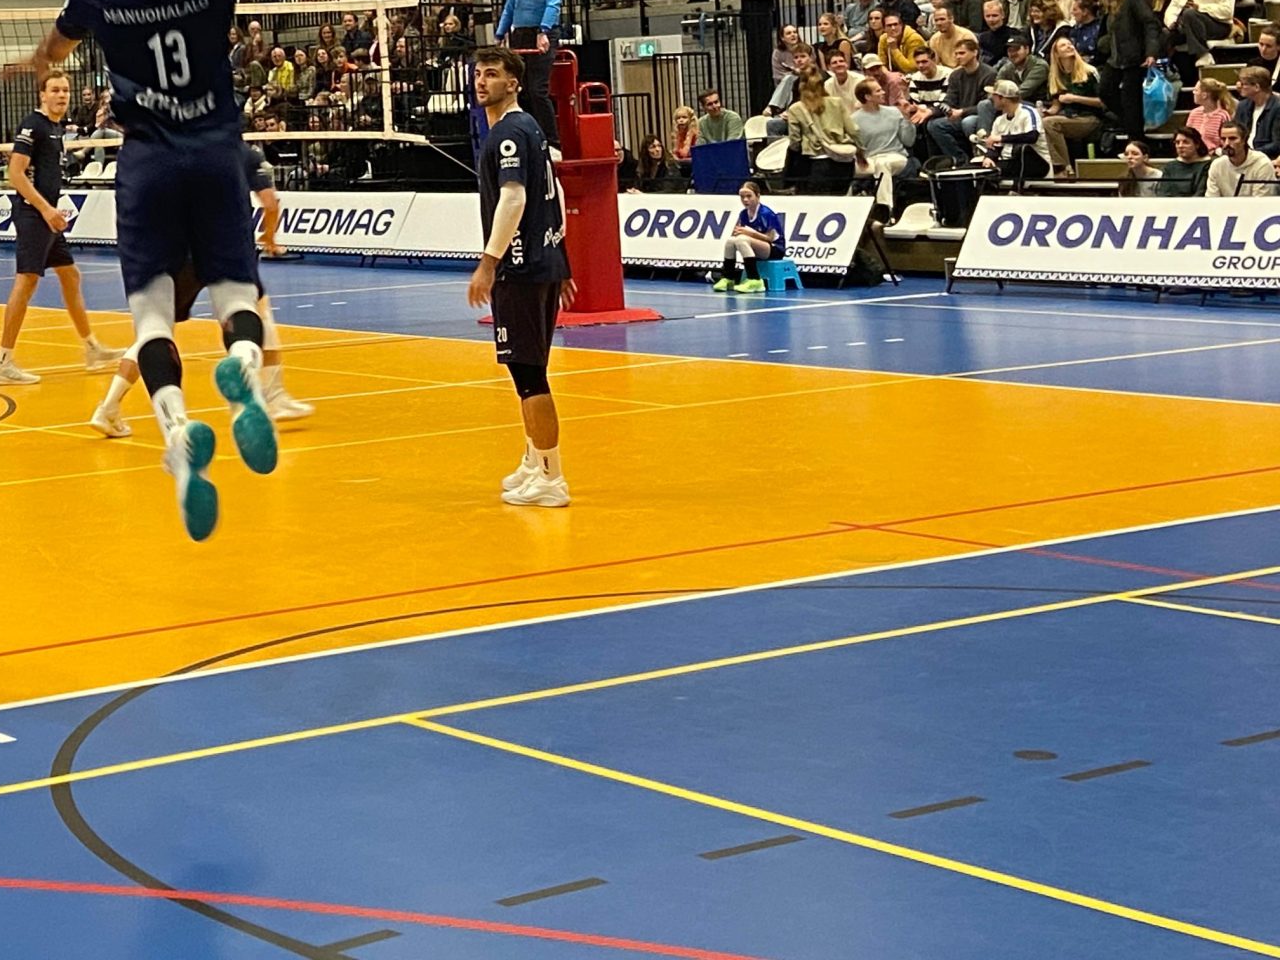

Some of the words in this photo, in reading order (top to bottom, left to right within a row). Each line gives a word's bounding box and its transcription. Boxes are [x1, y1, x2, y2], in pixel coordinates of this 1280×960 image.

[146, 30, 192, 90] 13
[624, 208, 731, 240] ORON
[784, 246, 837, 260] GROUP
